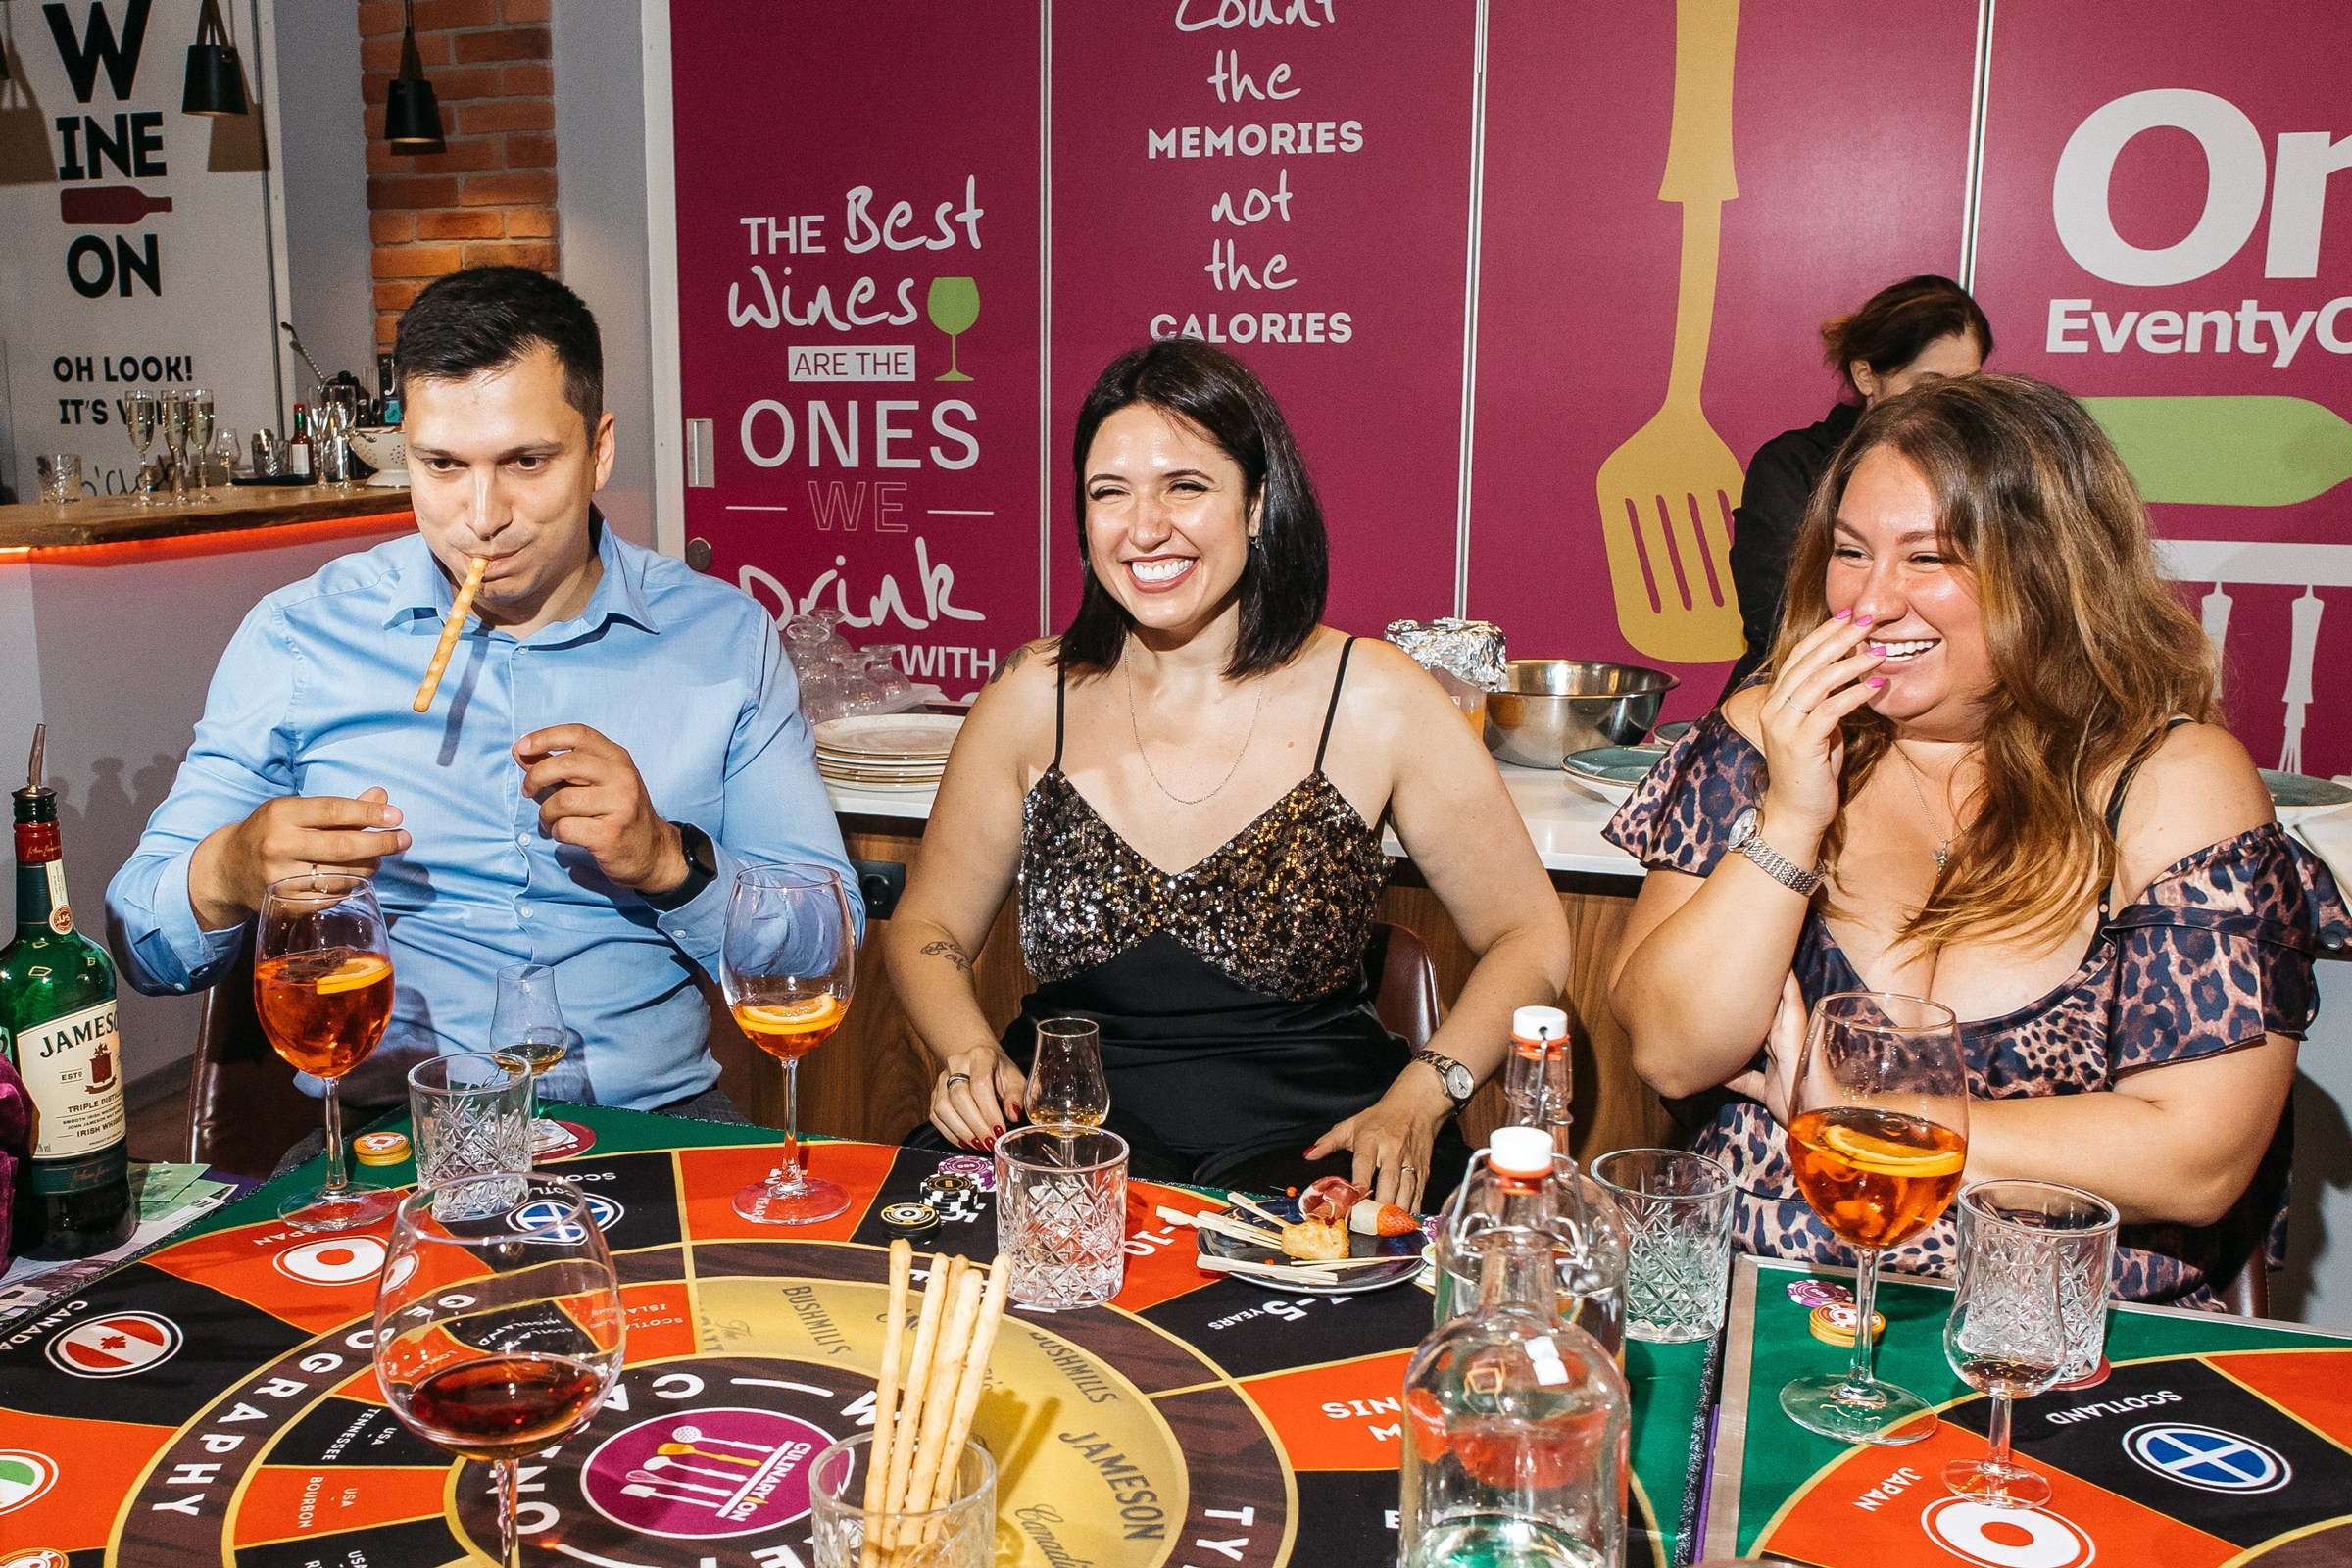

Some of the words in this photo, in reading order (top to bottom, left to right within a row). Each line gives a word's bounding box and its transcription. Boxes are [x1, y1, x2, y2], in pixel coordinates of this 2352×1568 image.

[43, 0, 151, 103] W
[1207, 49, 1301, 103] the
[55, 112, 167, 180] INE
[1148, 120, 1364, 159] MEMORIES
[740, 215, 826, 255] THE
[844, 174, 984, 254] Best
[1211, 168, 1293, 226] not
[67, 234, 162, 299] ON
[1204, 238, 1298, 291] the
[727, 265, 918, 331] Wines
[1150, 312, 1352, 344] CALORIES
[53, 356, 94, 382] OH
[104, 355, 193, 382] LOOK!
[794, 354, 849, 376] ARE
[856, 353, 909, 376] THE
[59, 399, 109, 425] IT'S
[741, 399, 980, 469] ONES
[808, 481, 908, 532] WE
[740, 536, 986, 632] Drink
[898, 645, 996, 679] WITH
[68, 1100, 99, 1113] TRIPLE
[77, 1125, 101, 1138] IRISH
[0, 1300, 88, 1351] CANADA
[782, 1285, 851, 1355] BUSHMILLS
[1207, 1302, 1264, 1331] YEARS
[2045, 1389, 2183, 1426] SCOTLAND
[321, 1408, 381, 1460] TENNESSEE
[371, 1427, 397, 1446] USA
[298, 1476, 324, 1528] BOURBON
[341, 1488, 358, 1507] USA
[1058, 1432, 1165, 1540] JAMESON
[1851, 1466, 1922, 1513] JAPAN
